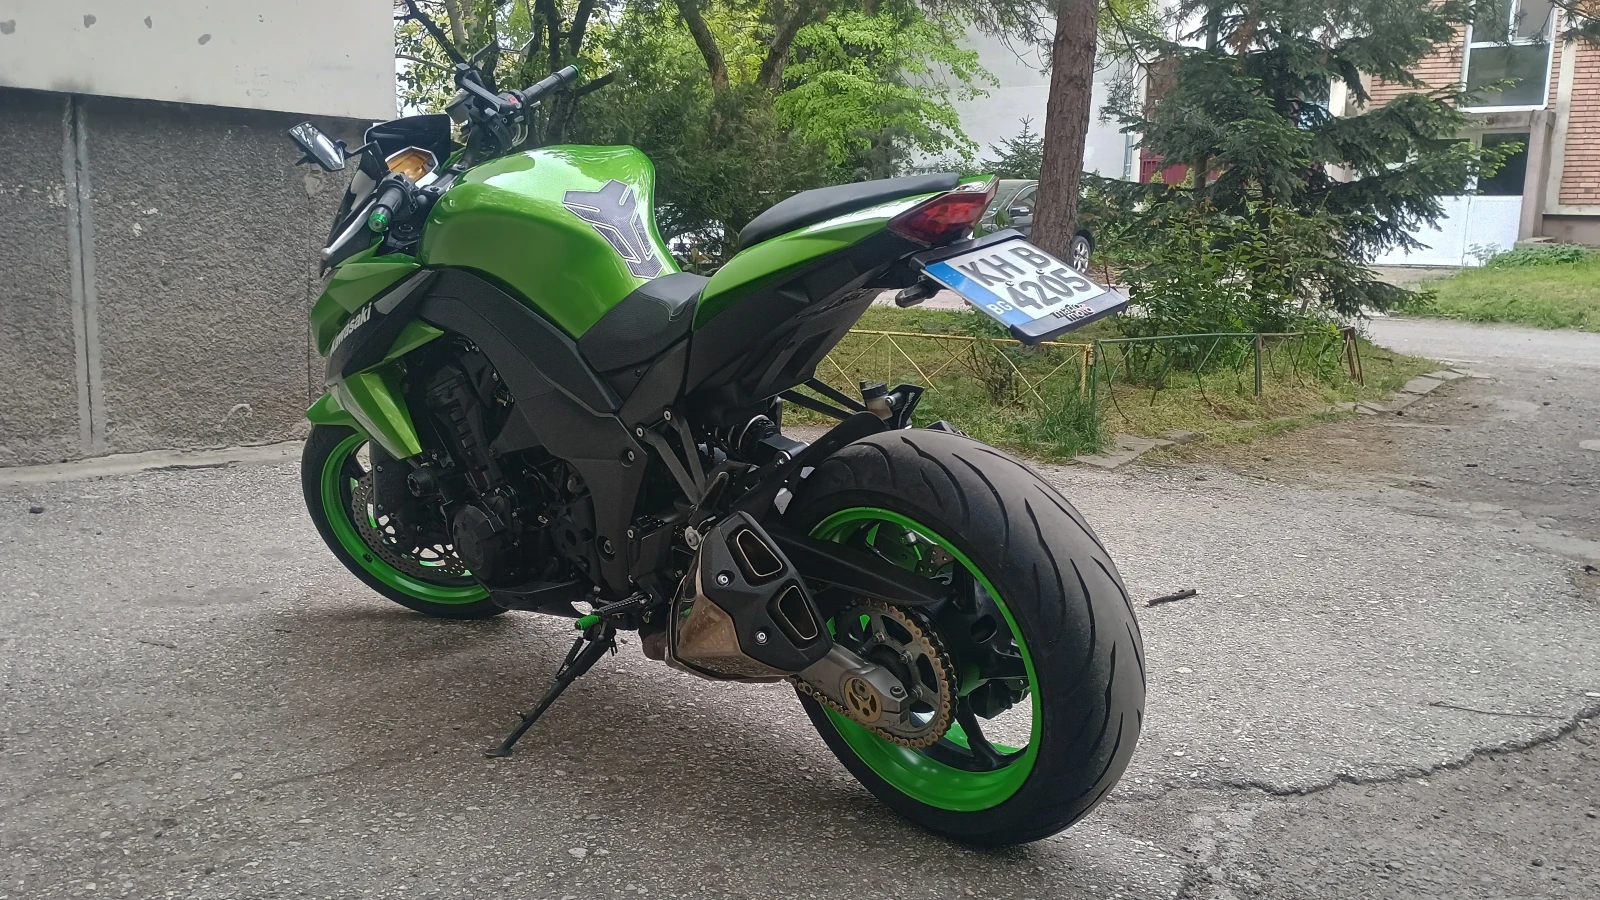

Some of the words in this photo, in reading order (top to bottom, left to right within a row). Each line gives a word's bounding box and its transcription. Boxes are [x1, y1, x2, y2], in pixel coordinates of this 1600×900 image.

[958, 254, 1027, 287] KH
[1008, 247, 1051, 269] B
[986, 301, 1014, 315] BG
[1006, 268, 1092, 310] 4205
